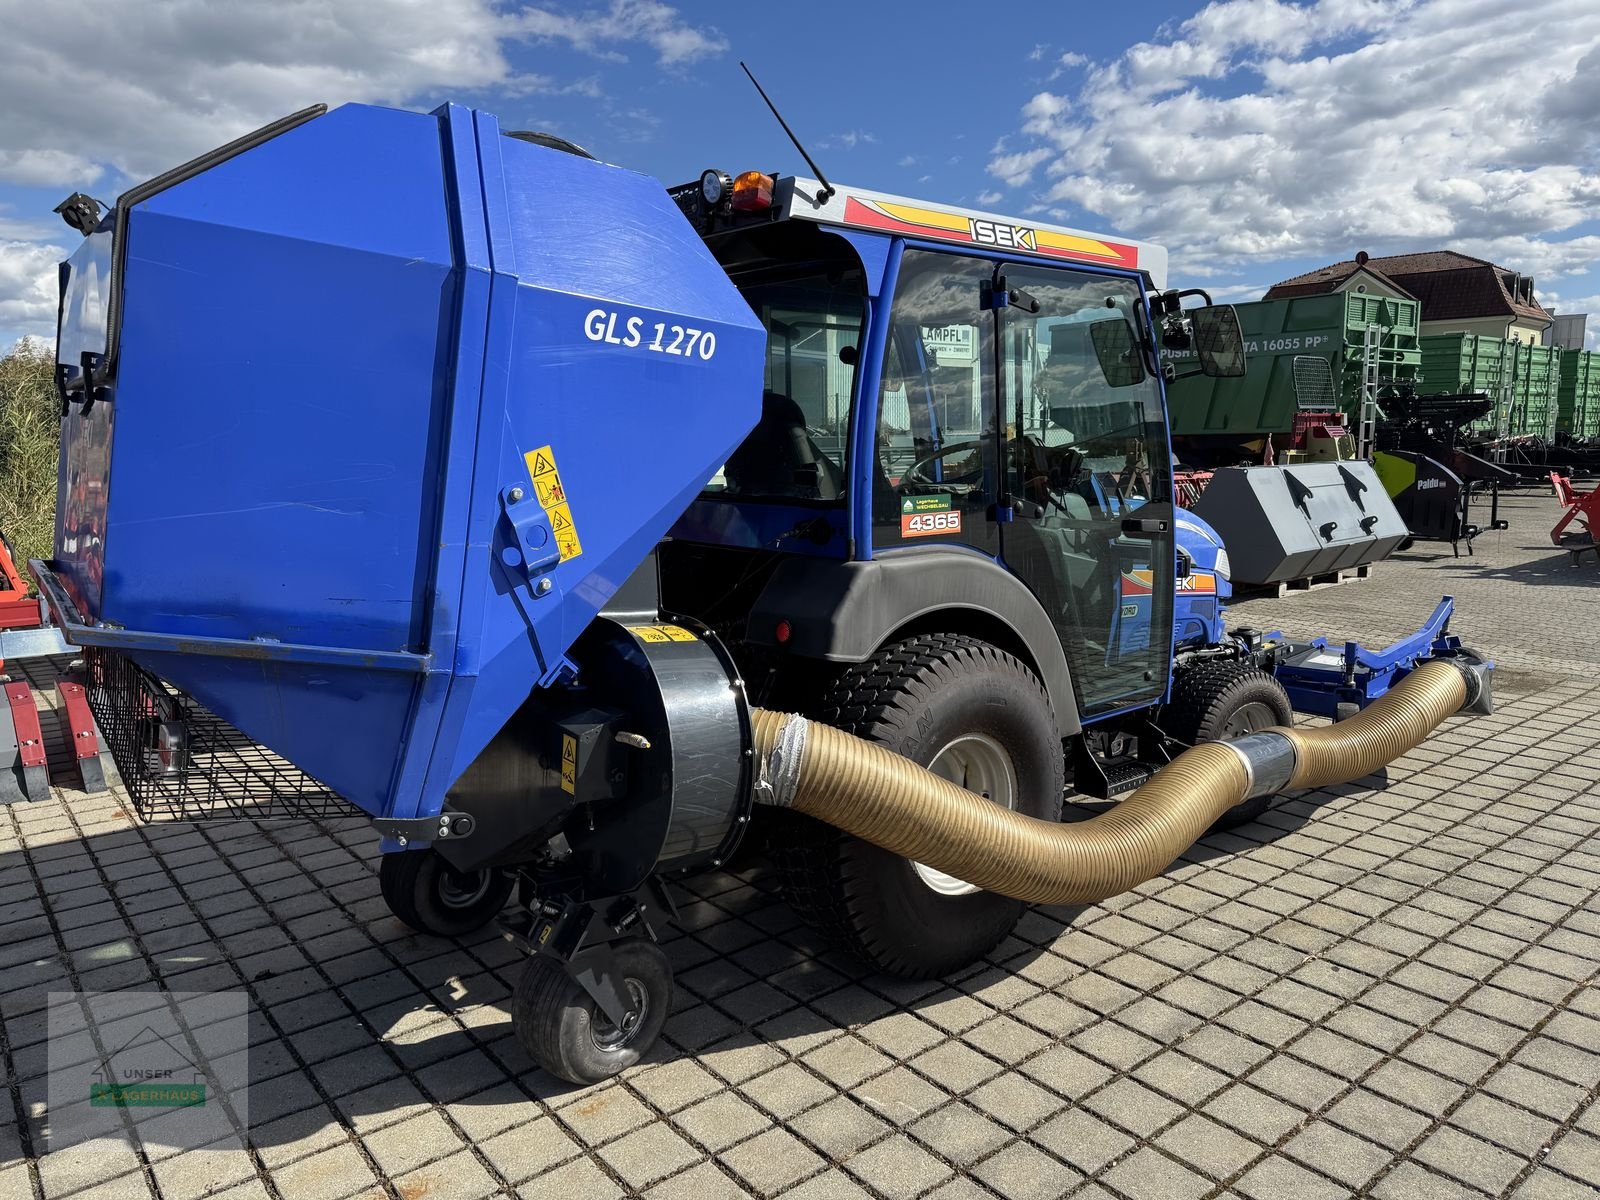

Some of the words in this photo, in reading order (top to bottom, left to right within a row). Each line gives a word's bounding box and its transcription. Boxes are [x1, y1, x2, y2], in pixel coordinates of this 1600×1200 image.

[968, 218, 1037, 251] ISEKI
[584, 308, 644, 348] GLS
[649, 322, 716, 361] 1270
[1262, 337, 1300, 351] 16055
[1417, 478, 1439, 490] Paldu
[909, 512, 959, 531] 4365
